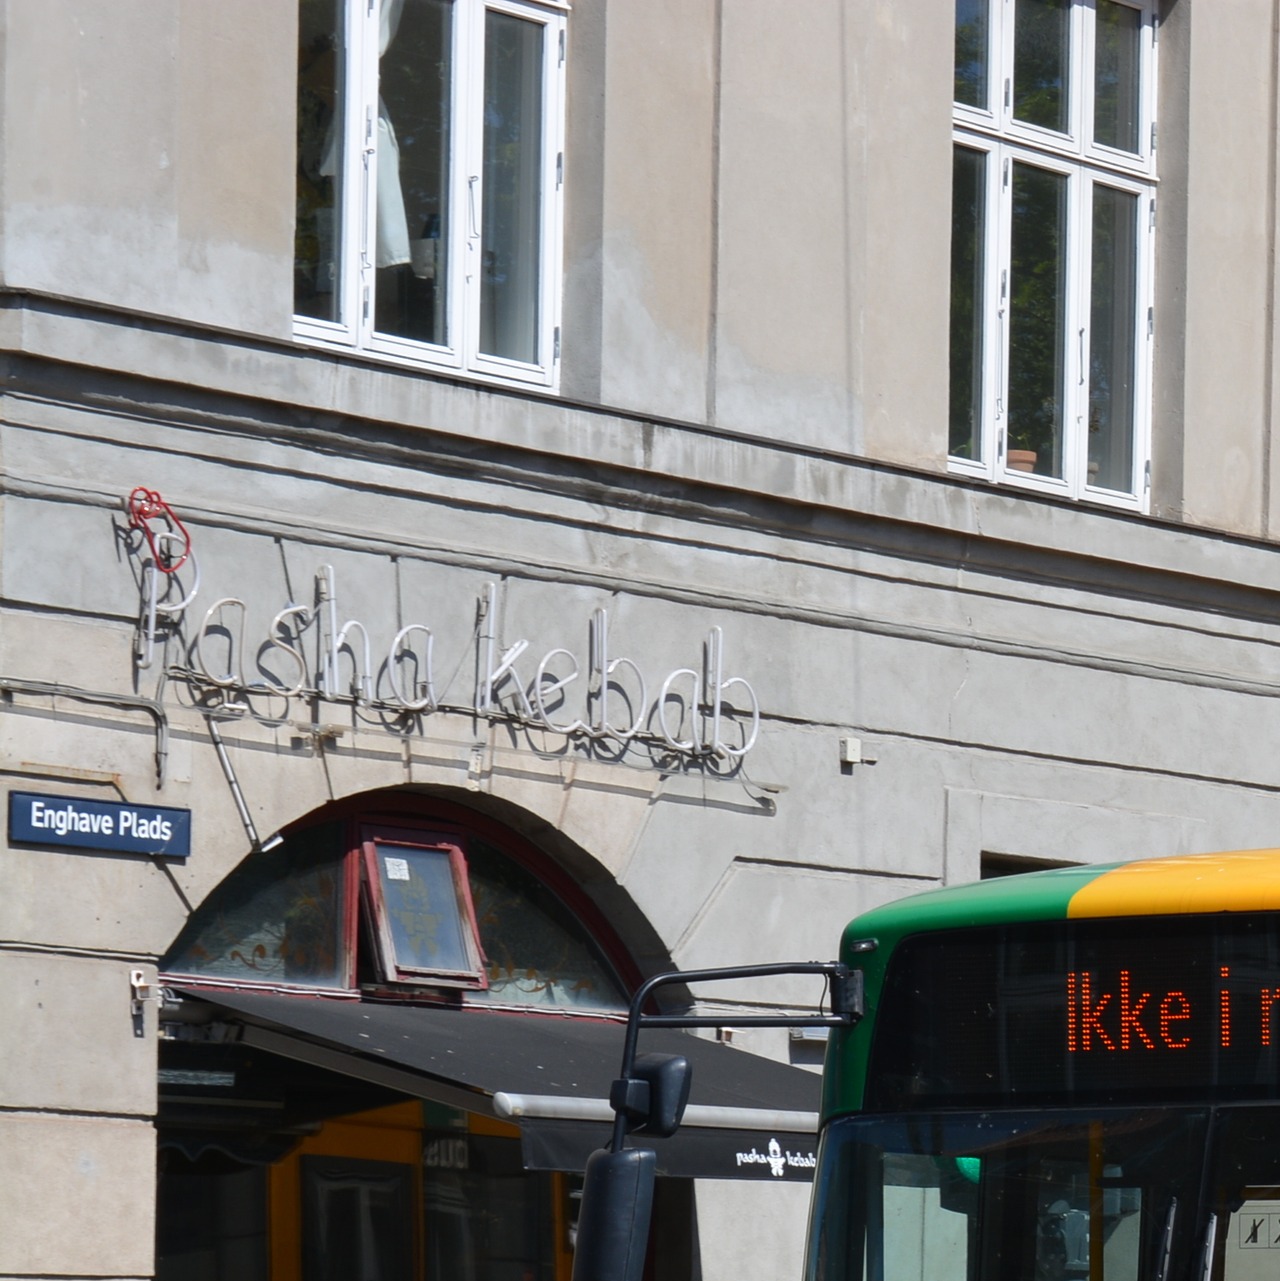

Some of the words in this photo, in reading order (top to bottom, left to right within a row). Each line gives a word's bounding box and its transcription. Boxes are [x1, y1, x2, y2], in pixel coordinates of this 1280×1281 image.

[31, 801, 114, 836] Enghave
[119, 810, 172, 841] Plads
[1067, 970, 1191, 1051] Ikke
[1220, 966, 1230, 1047] i
[736, 1148, 768, 1166] pasha
[785, 1150, 816, 1168] kebab
